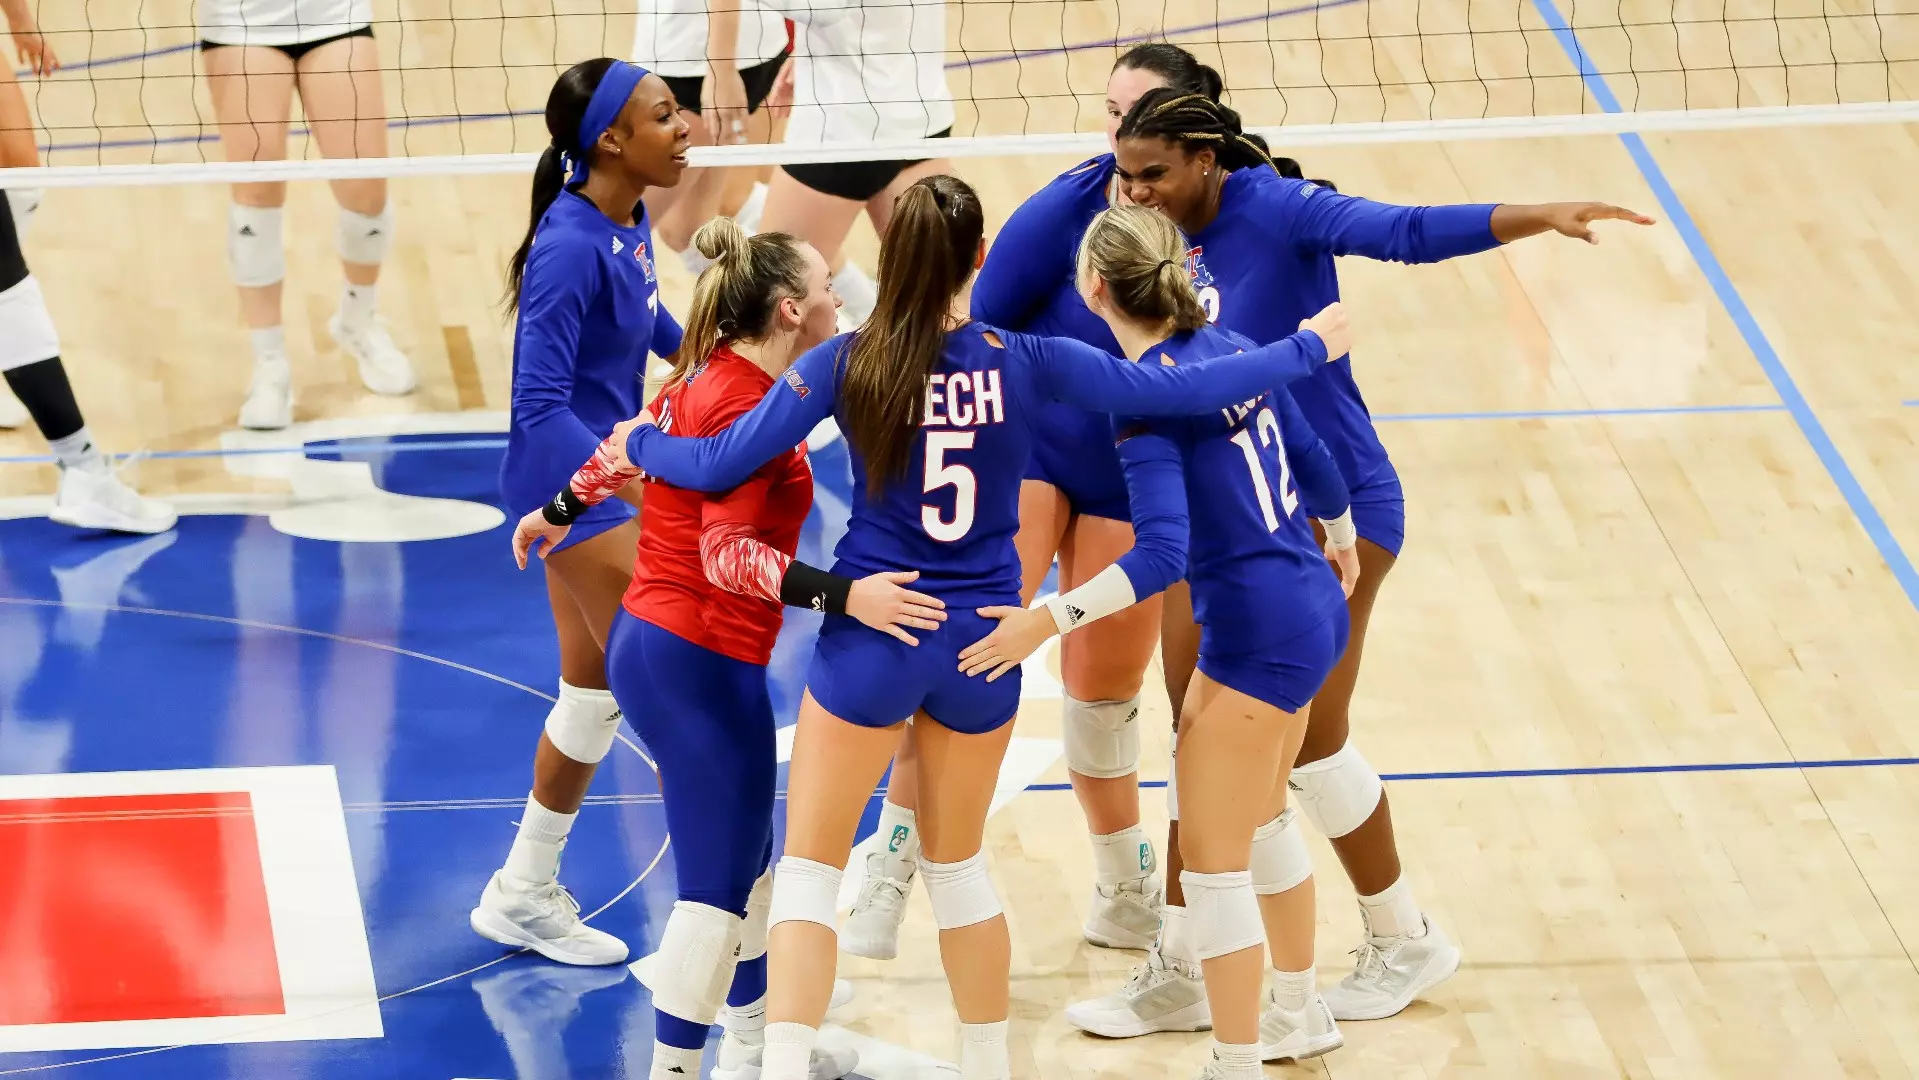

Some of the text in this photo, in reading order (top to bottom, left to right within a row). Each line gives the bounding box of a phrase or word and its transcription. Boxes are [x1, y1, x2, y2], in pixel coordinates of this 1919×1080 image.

[908, 368, 1005, 427] ECH
[920, 429, 978, 543] 5
[1229, 407, 1299, 534] 12
